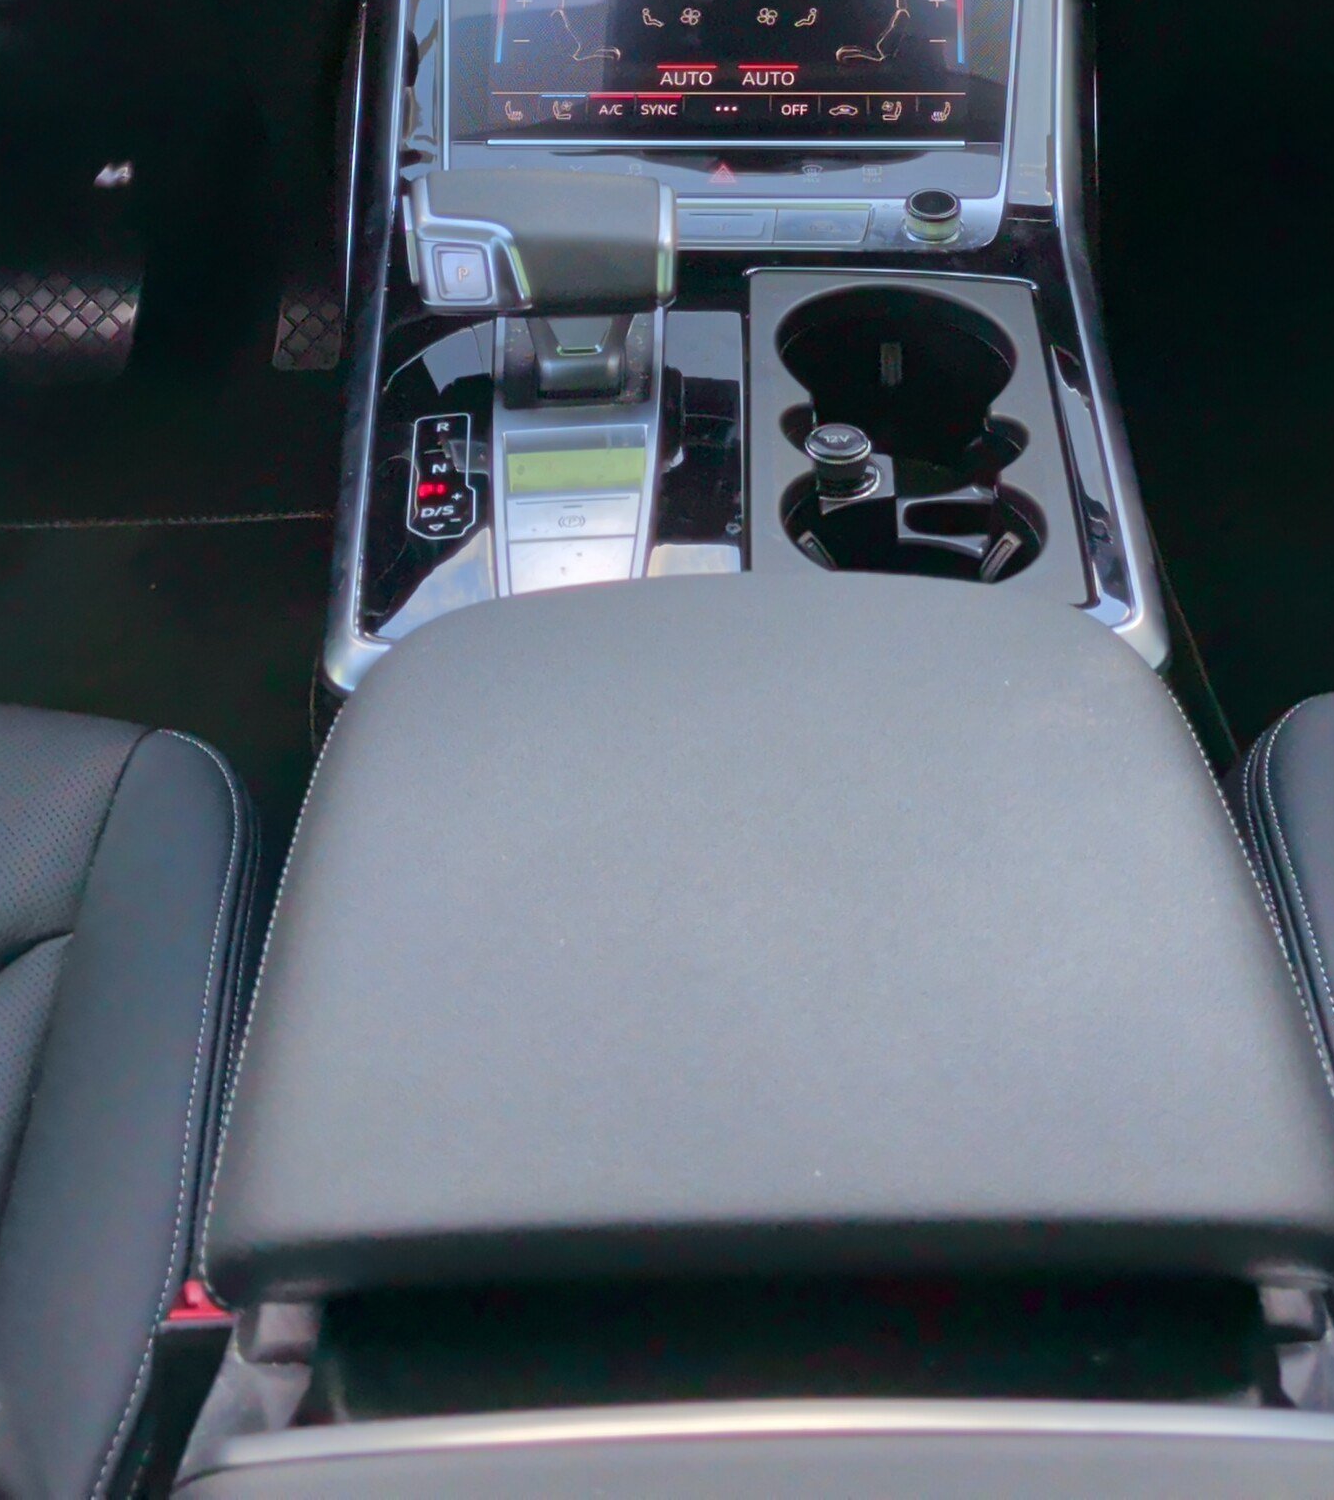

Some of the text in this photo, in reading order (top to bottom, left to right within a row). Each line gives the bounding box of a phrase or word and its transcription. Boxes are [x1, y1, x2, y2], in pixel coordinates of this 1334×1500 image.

[659, 71, 713, 86] AUTO
[742, 71, 795, 86] AUTO
[599, 104, 623, 116] A/C
[640, 104, 678, 116] SYNC
[781, 104, 808, 116] OFF
[458, 267, 468, 282] P
[436, 422, 450, 433] R
[824, 435, 849, 444] 12V
[432, 463, 447, 474] N
[420, 505, 454, 518] D/S
